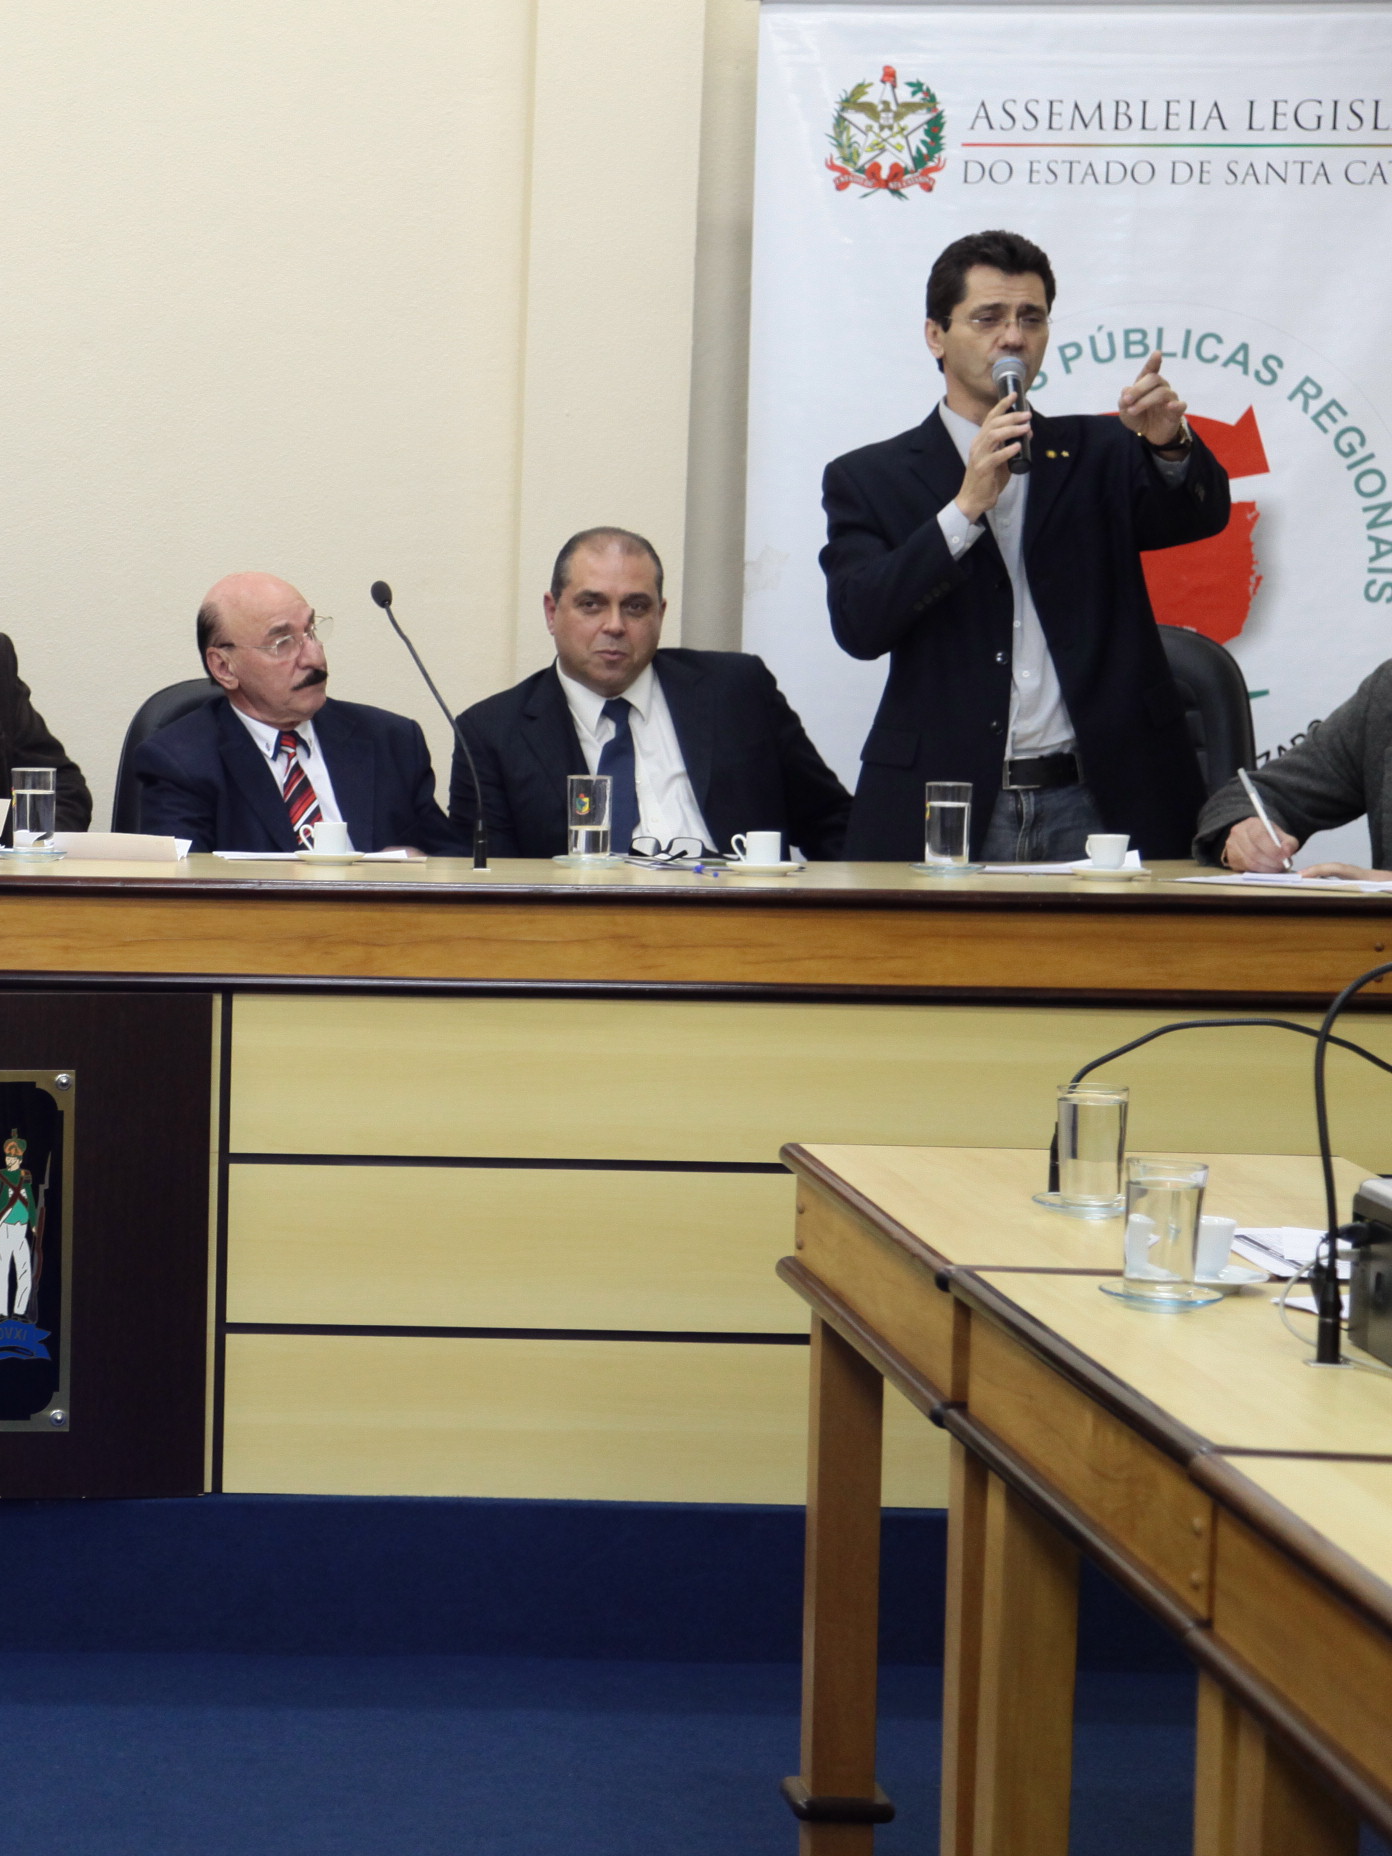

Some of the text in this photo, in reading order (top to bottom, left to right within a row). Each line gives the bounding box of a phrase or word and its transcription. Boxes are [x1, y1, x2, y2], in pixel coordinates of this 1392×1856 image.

[968, 99, 1229, 133] ASSEMBLEIA
[961, 159, 1014, 186] DO
[1027, 159, 1157, 186] ESTADO
[1169, 159, 1212, 186] DE
[1224, 159, 1334, 186] SANTA
[1057, 324, 1285, 387] PÚBLICAS
